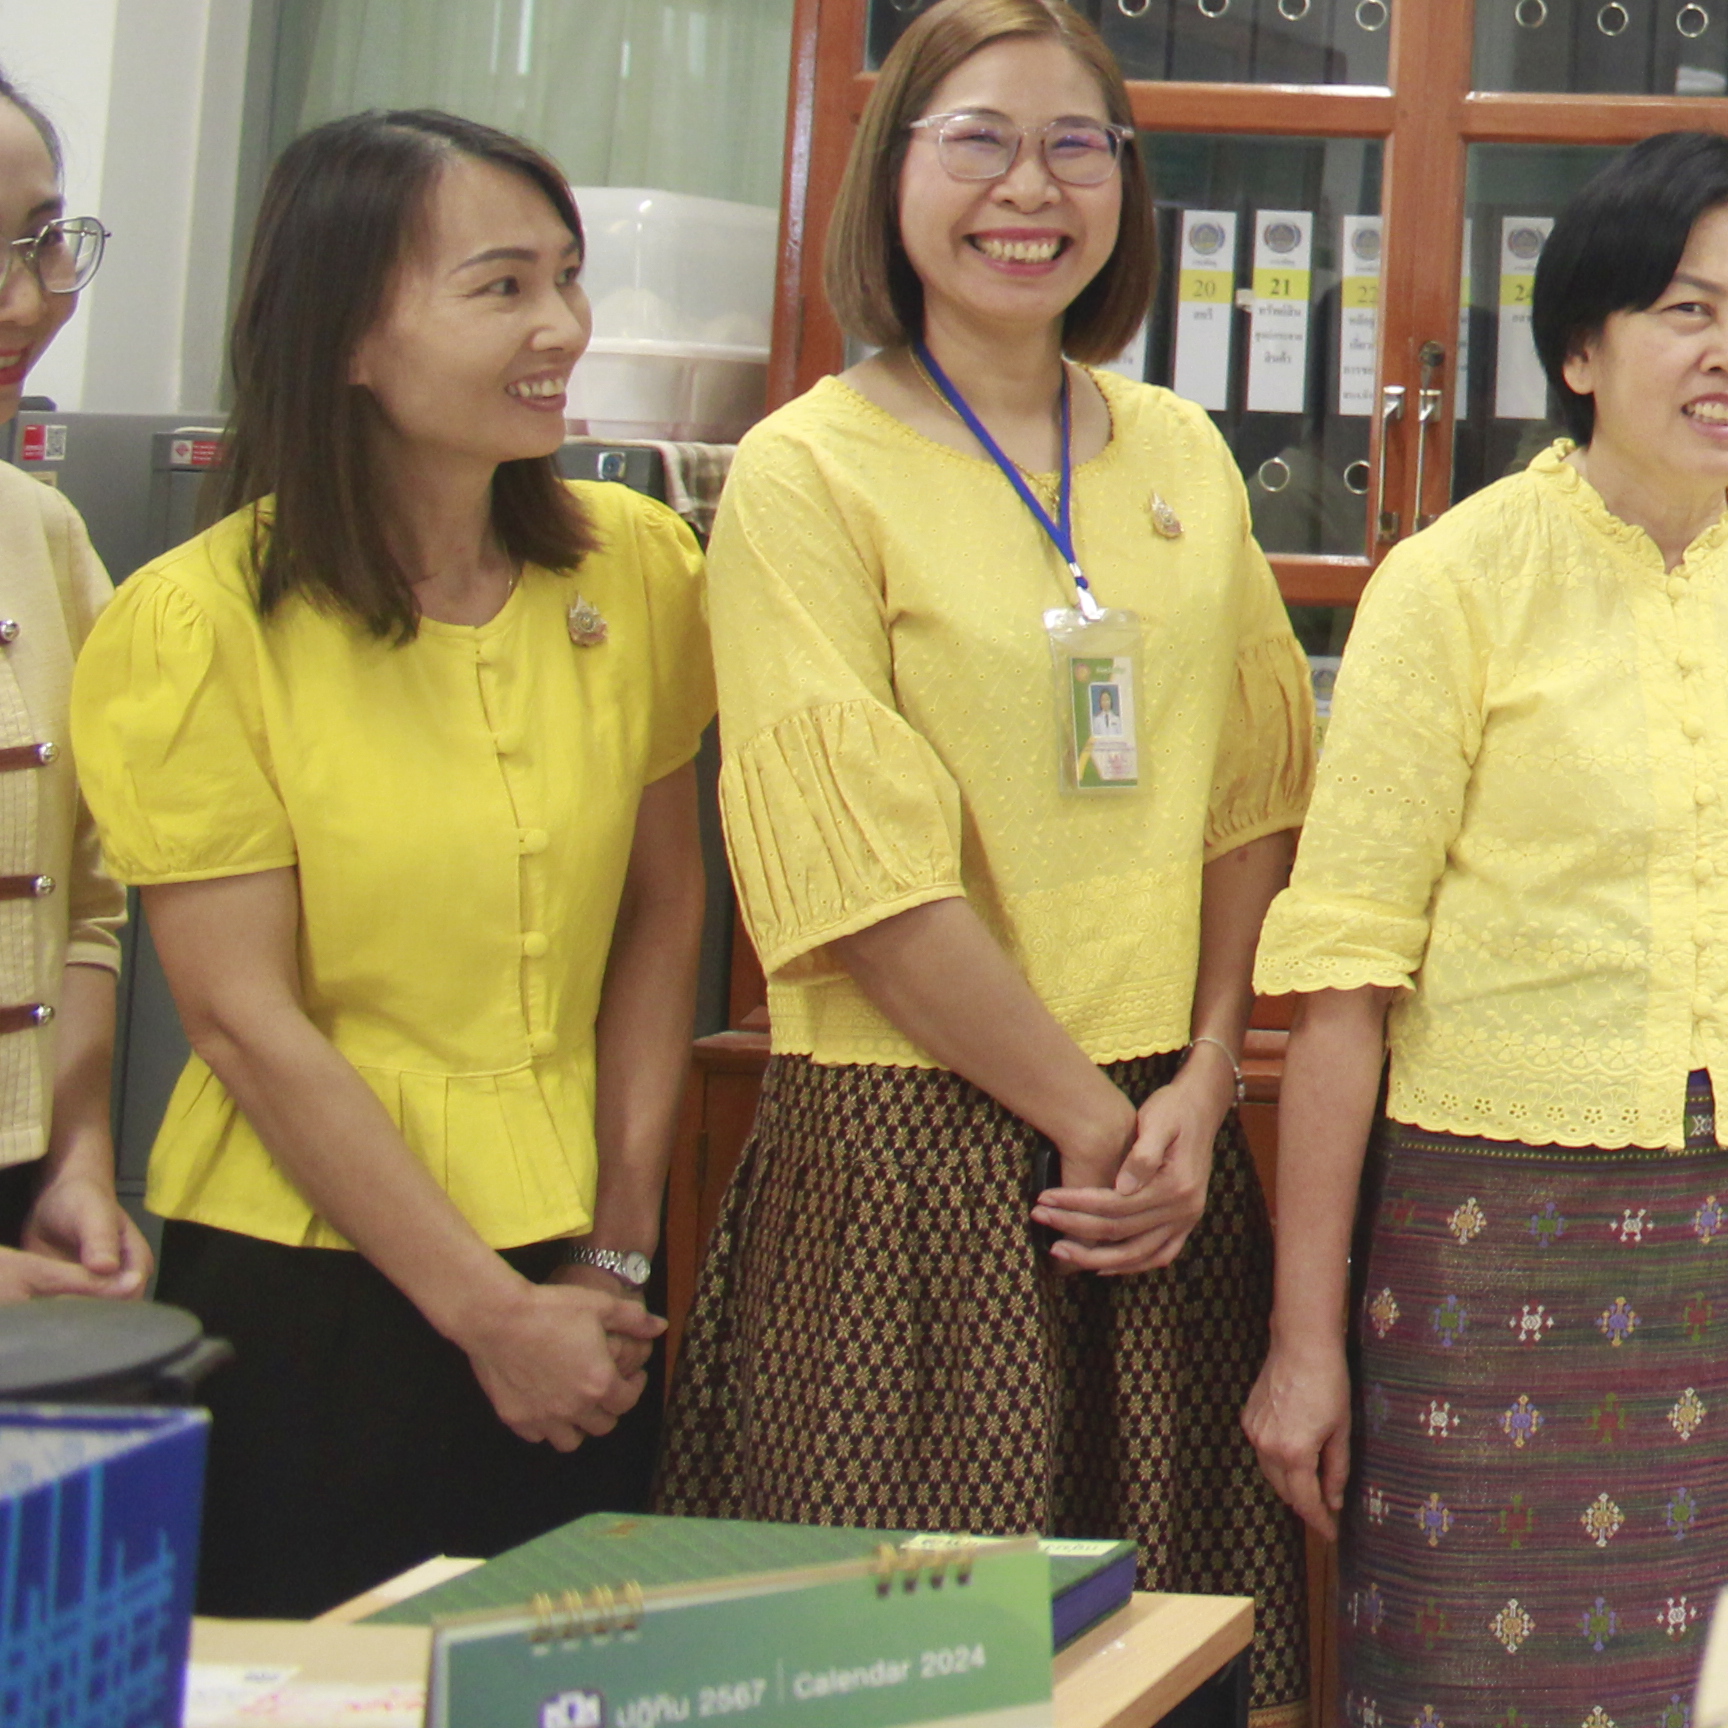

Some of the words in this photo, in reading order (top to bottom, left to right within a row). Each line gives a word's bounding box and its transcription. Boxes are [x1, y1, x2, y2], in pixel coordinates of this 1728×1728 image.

[1192, 279, 1216, 298] 20
[1271, 278, 1291, 296] 21
[700, 1676, 768, 1717] 2567
[792, 1656, 912, 1701] Calendar
[920, 1642, 988, 1681] 2024
